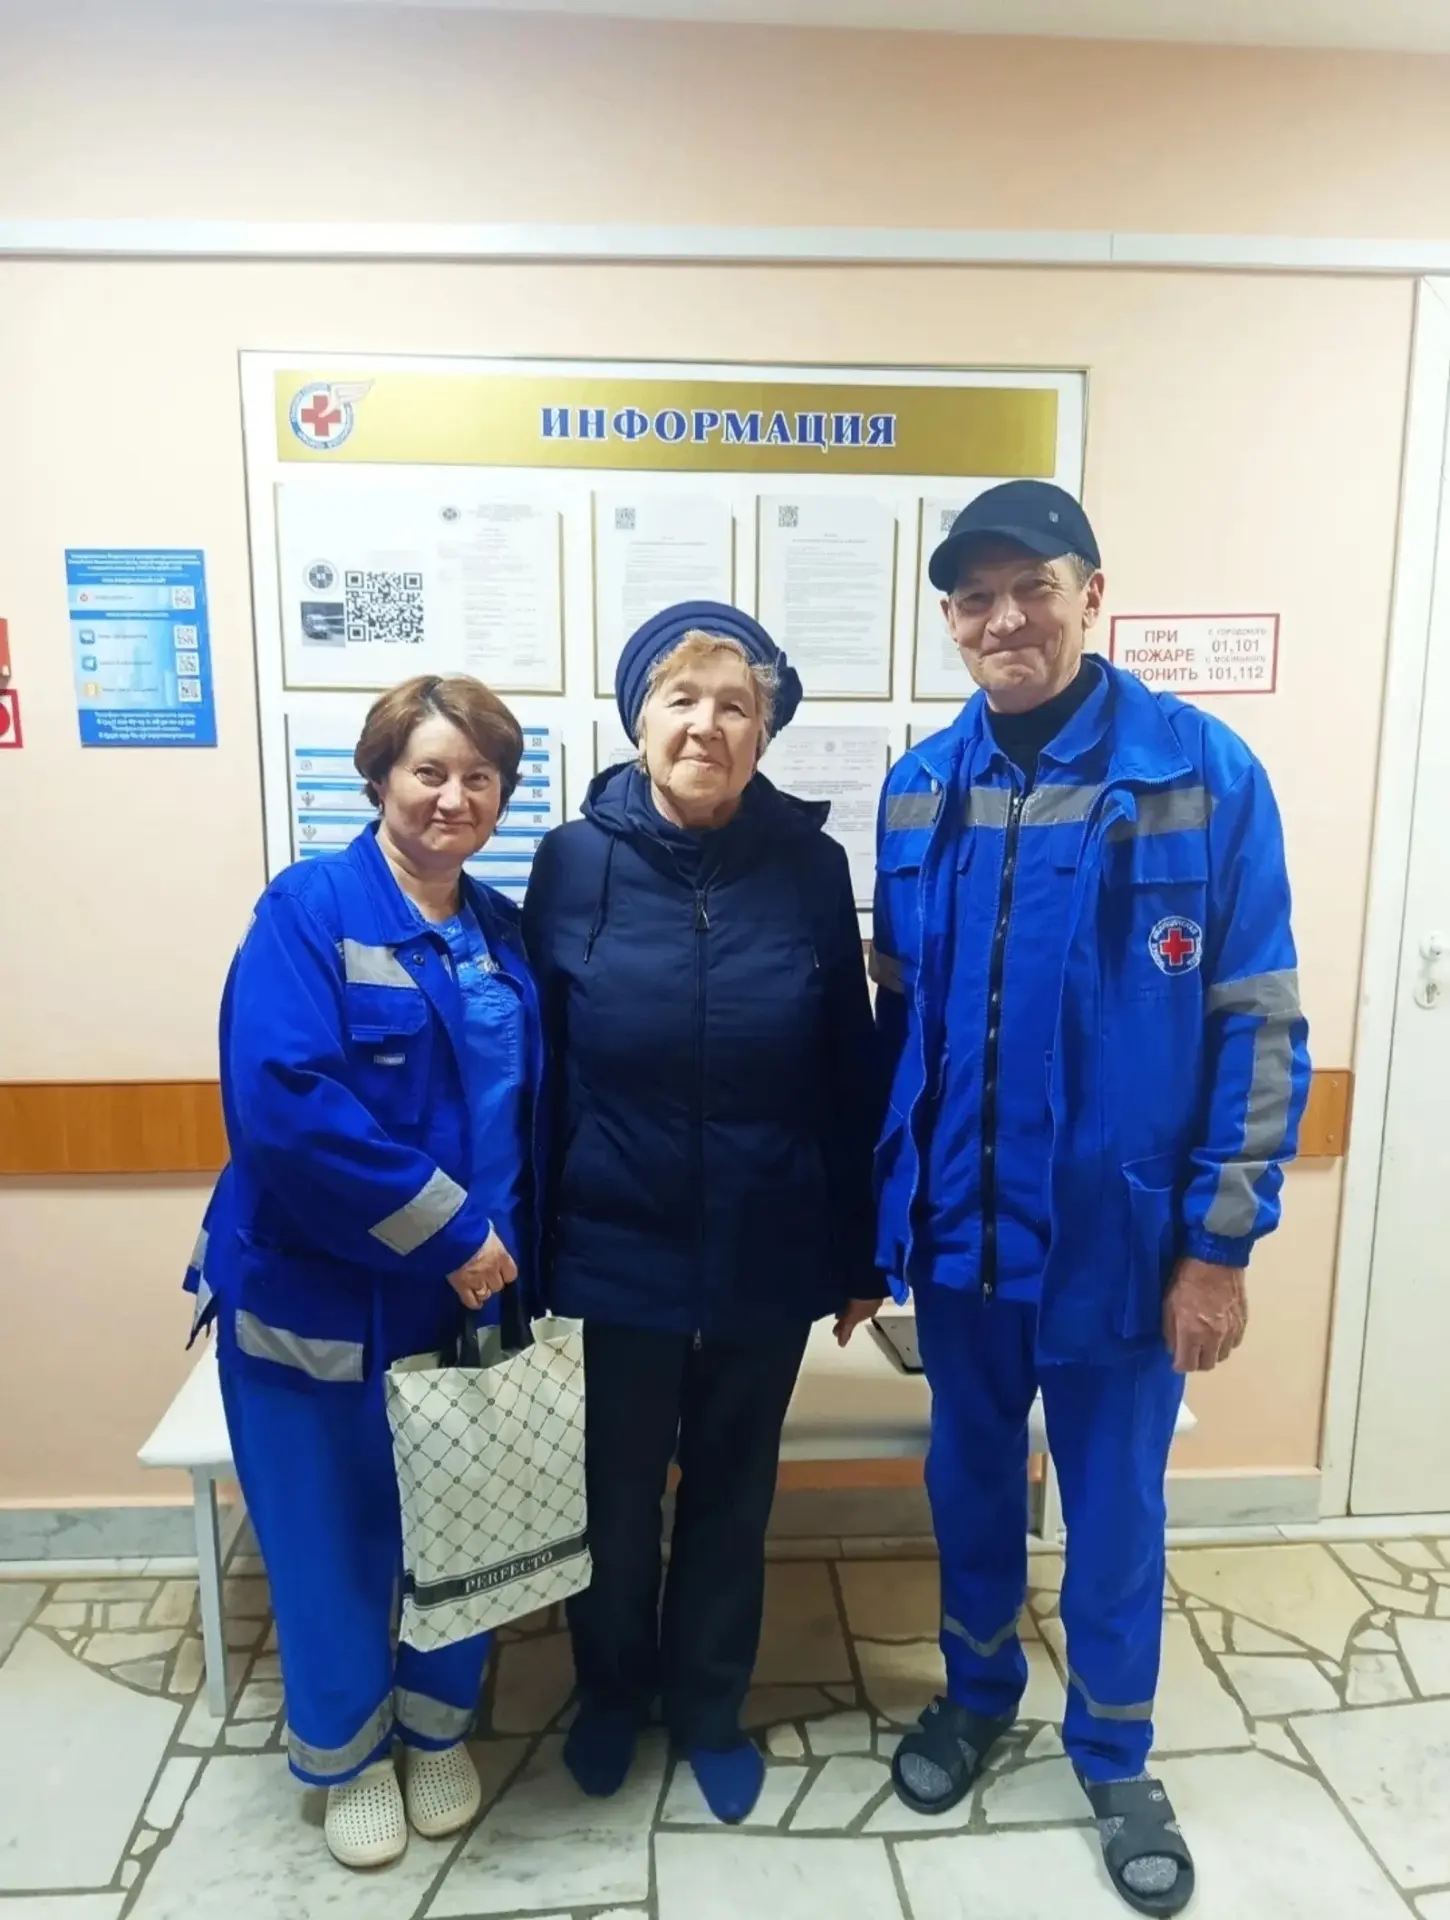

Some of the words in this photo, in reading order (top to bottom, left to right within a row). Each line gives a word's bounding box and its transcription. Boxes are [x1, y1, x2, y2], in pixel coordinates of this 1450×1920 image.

[540, 406, 896, 453] ИНФОРМАЦИЯ
[1144, 630, 1178, 643] ПРИ
[1125, 648, 1195, 662] ПОЖАРЕ
[1131, 667, 1199, 681] ВОНИТЬ
[1207, 666, 1265, 682] 101,112
[464, 1551, 553, 1593] PERFECTO
